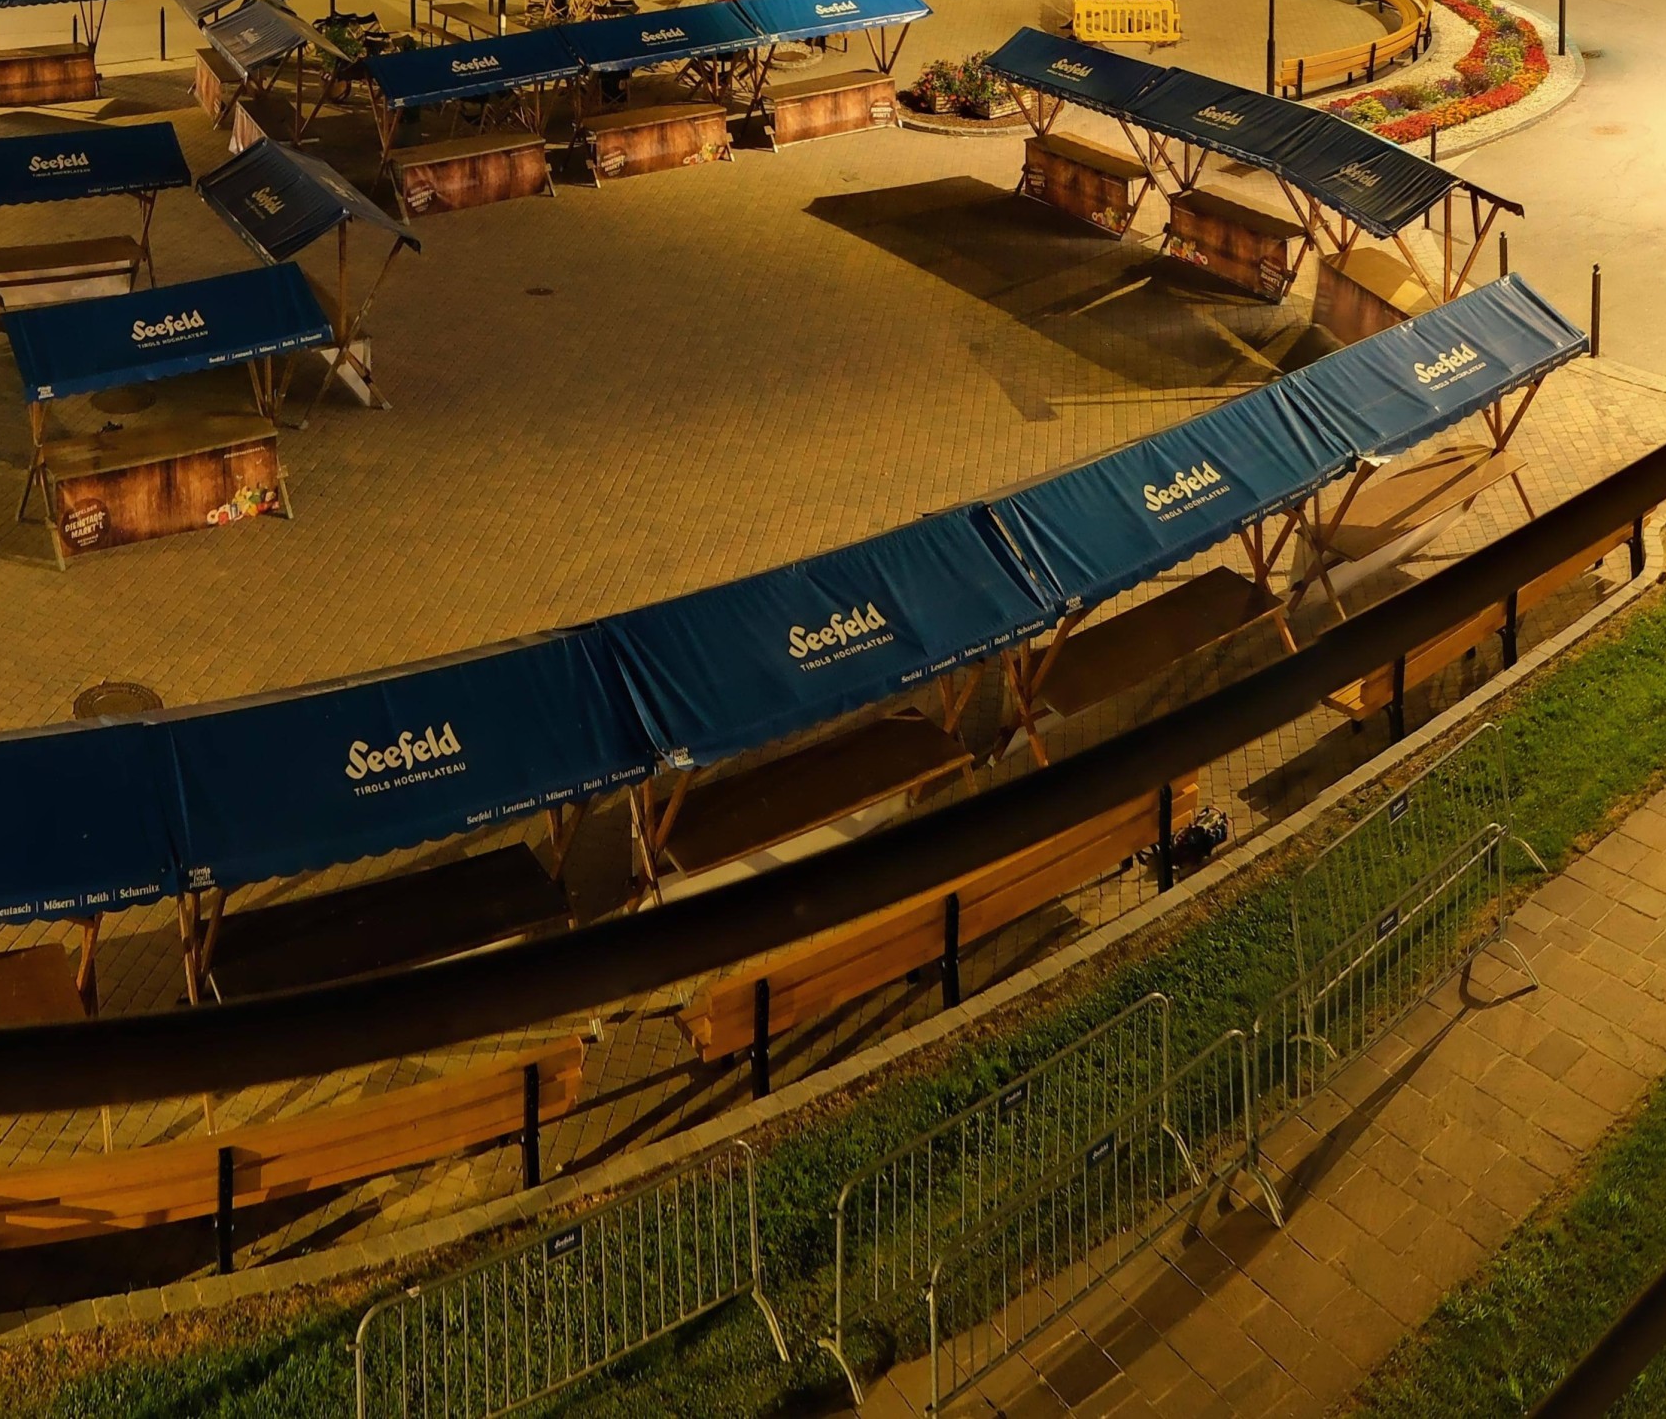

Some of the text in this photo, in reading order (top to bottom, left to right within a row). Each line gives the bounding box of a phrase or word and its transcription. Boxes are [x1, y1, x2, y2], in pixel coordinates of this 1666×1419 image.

[815, 0, 857, 15] Seefeld
[641, 27, 685, 43] Seefeld
[451, 55, 499, 73] Seefeld
[29, 152, 89, 173] Seefeld
[131, 310, 205, 342] Seefeld
[1414, 342, 1477, 384] Seefeld
[1144, 460, 1222, 512] Seefeld
[1157, 484, 1231, 523] TIROLS HOCHPLATEAU
[788, 601, 888, 660] Seefeld
[800, 632, 895, 672] TIROLS HOCHPLATEAU
[901, 620, 1045, 683] Seefeld Leutasch Mösern Reith Scharnitz
[345, 721, 462, 780] Seefeld
[354, 761, 467, 797] TIROLS HOCHPLATEAU
[466, 765, 646, 825] Seefeld Leutasch Mösern Reith Scharnitz
[43, 897, 75, 911] Mösern
[87, 890, 109, 904] Reith
[120, 883, 161, 899] Scharnitz
